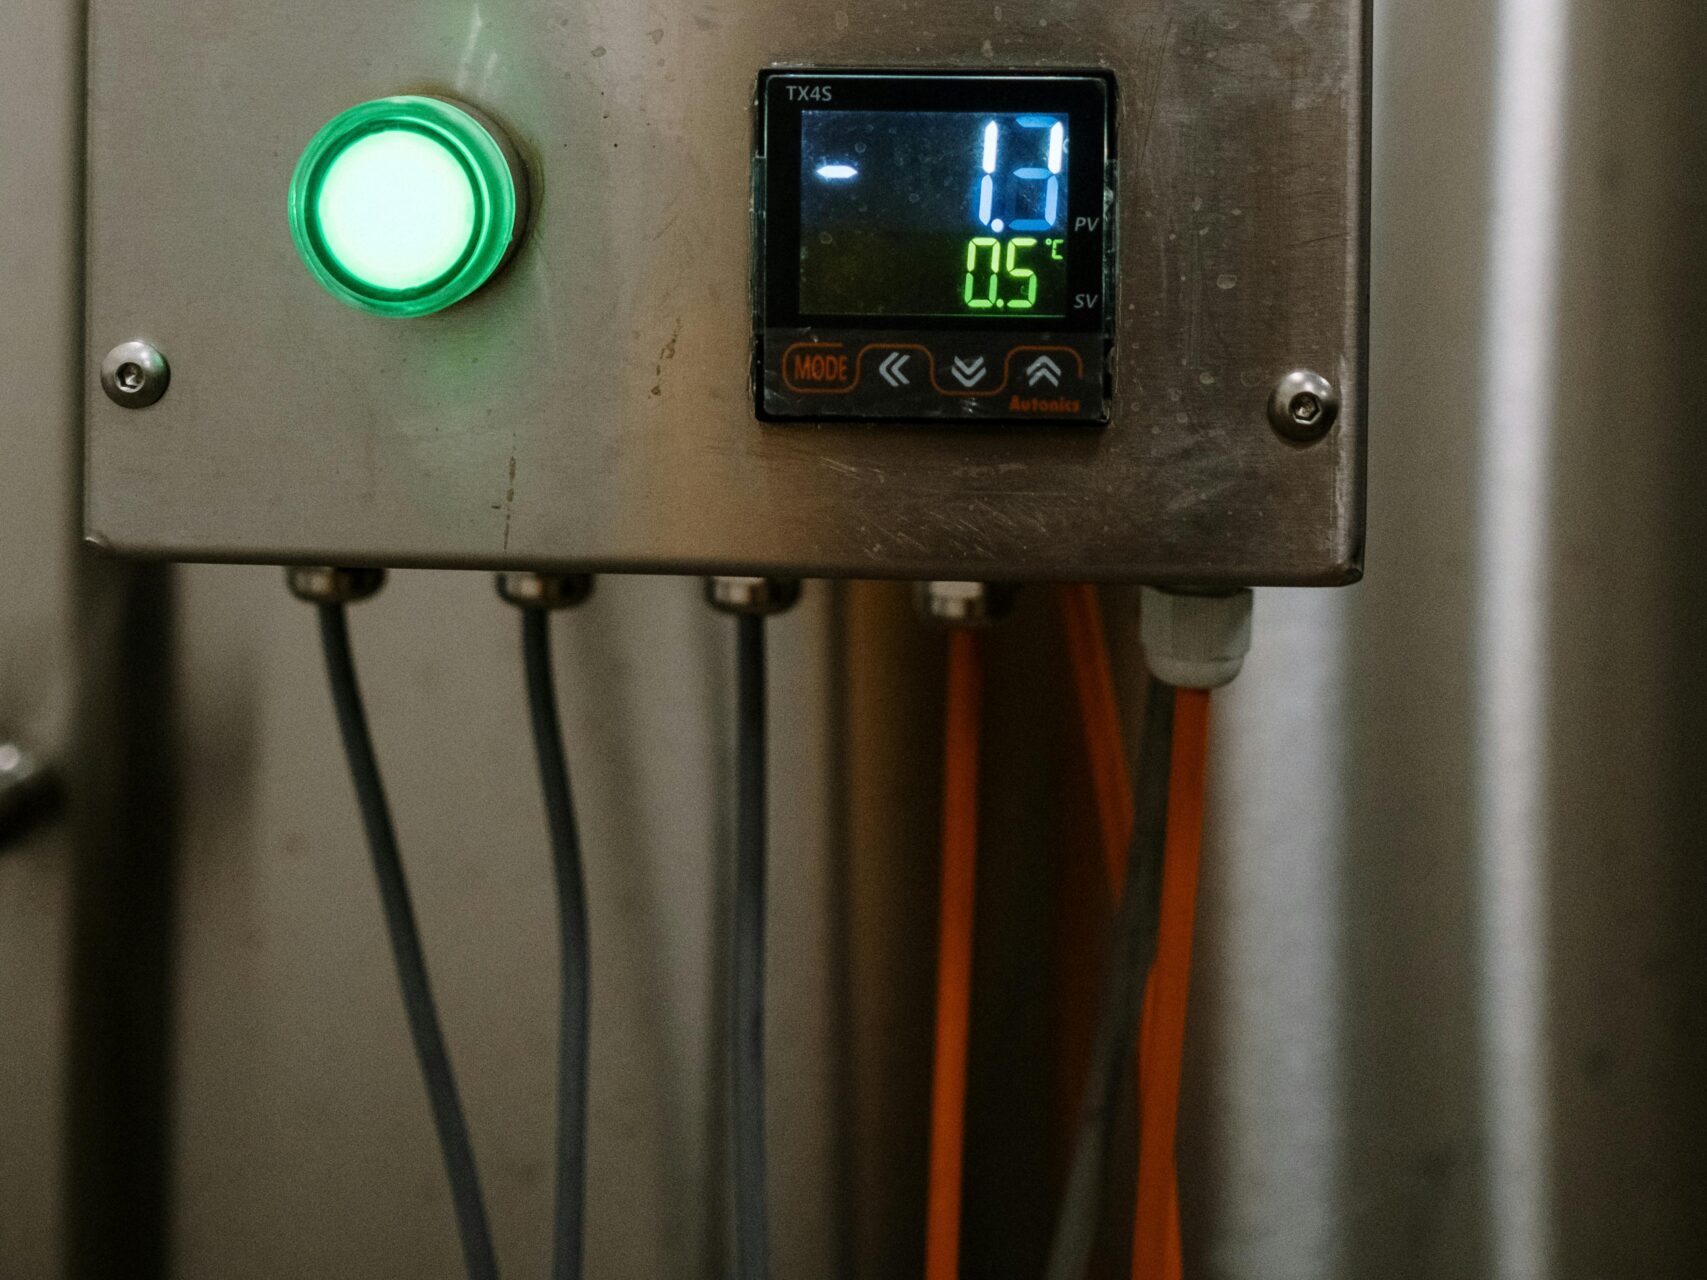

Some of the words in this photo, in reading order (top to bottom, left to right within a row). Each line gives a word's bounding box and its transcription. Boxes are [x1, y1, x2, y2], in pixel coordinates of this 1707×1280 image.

[786, 85, 832, 102] TX4S
[1074, 217, 1099, 232] PV
[964, 236, 1037, 309] 0.5
[1073, 294, 1098, 309] SV
[794, 355, 848, 382] MODE
[1009, 396, 1080, 413] Autonics
